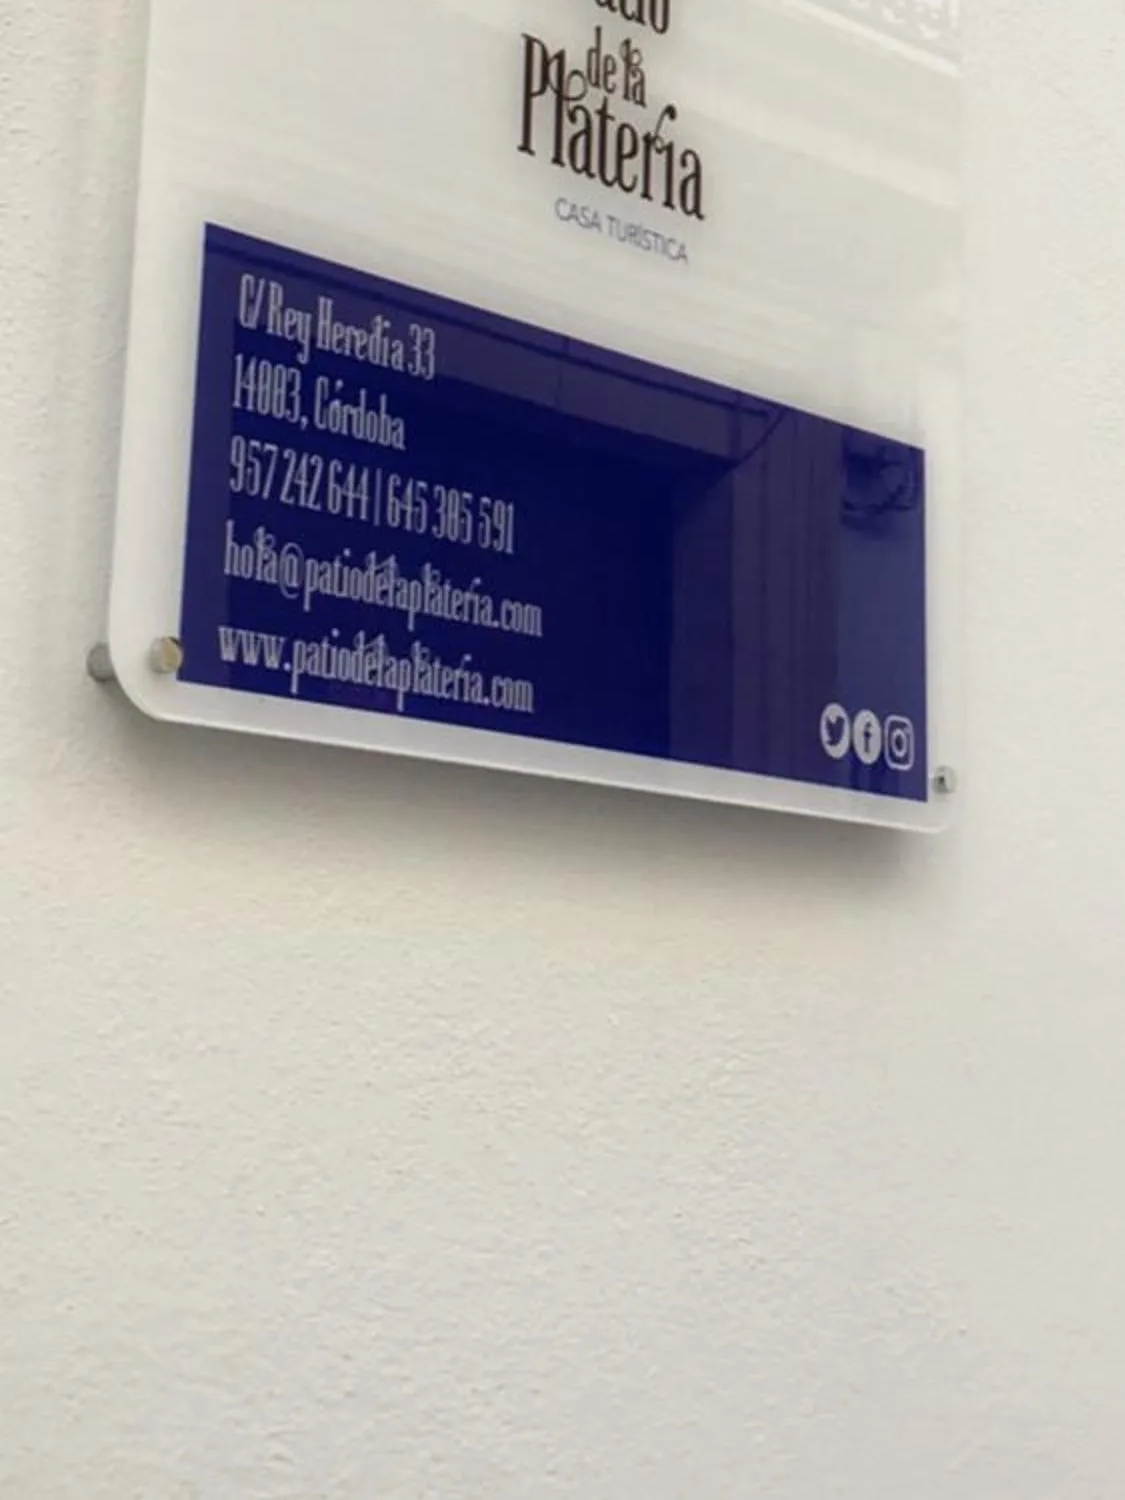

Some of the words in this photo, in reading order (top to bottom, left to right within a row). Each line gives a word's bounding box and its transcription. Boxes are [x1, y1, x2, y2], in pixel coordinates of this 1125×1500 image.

[586, 25, 617, 94] de
[620, 37, 648, 108] la
[554, 196, 602, 233] CASA
[266, 280, 312, 365] Rey
[315, 295, 405, 373] Heredia
[407, 322, 436, 381] 33
[313, 374, 406, 451] Córdoba
[229, 435, 279, 500] 957
[279, 447, 323, 512] 242
[326, 458, 370, 522] 644
[385, 472, 429, 535] 645
[477, 496, 516, 555] 591
